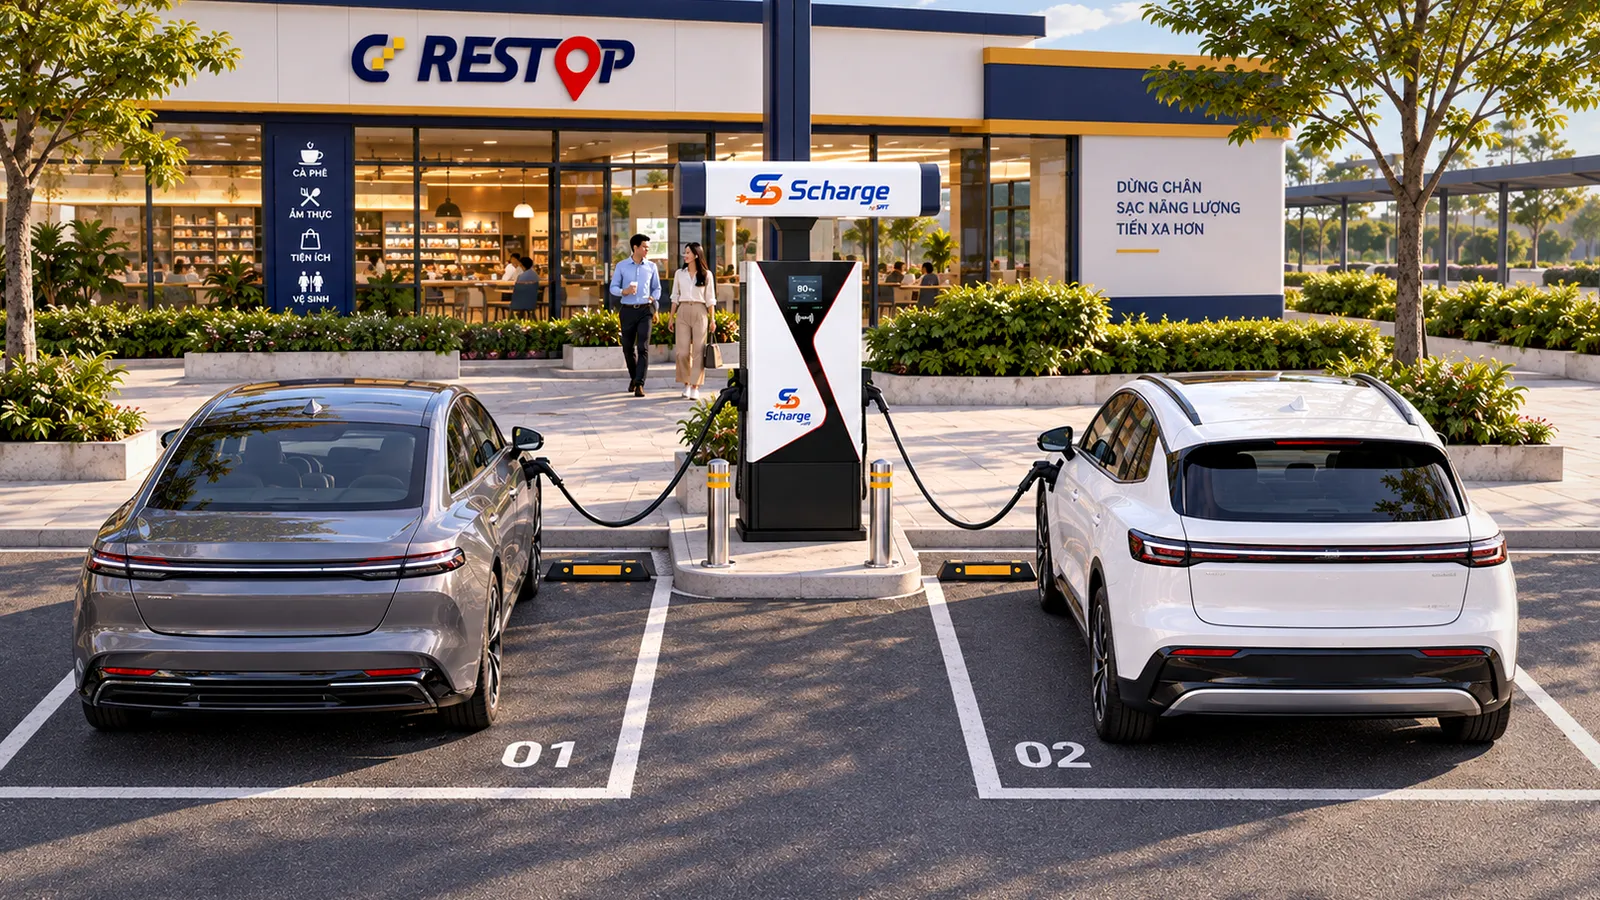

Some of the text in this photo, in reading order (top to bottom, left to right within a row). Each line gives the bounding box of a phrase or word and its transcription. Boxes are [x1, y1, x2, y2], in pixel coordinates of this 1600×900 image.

[417, 35, 635, 101] RESTOP
[308, 167, 328, 177] PHÊ
[789, 180, 890, 205] Scharge
[1117, 178, 1202, 193] DỪNG CHÂN
[306, 210, 332, 220] THỰC
[1117, 201, 1145, 216] SẠC
[1193, 201, 1240, 217] LƯỢNG
[1116, 219, 1204, 235] TIẾN XA HƠN
[291, 252, 330, 263] TIỆN ÍCH
[292, 294, 330, 305] VỆ SINH
[765, 411, 811, 423] Scharge
[501, 741, 575, 767] 01
[1015, 741, 1092, 768] 02
